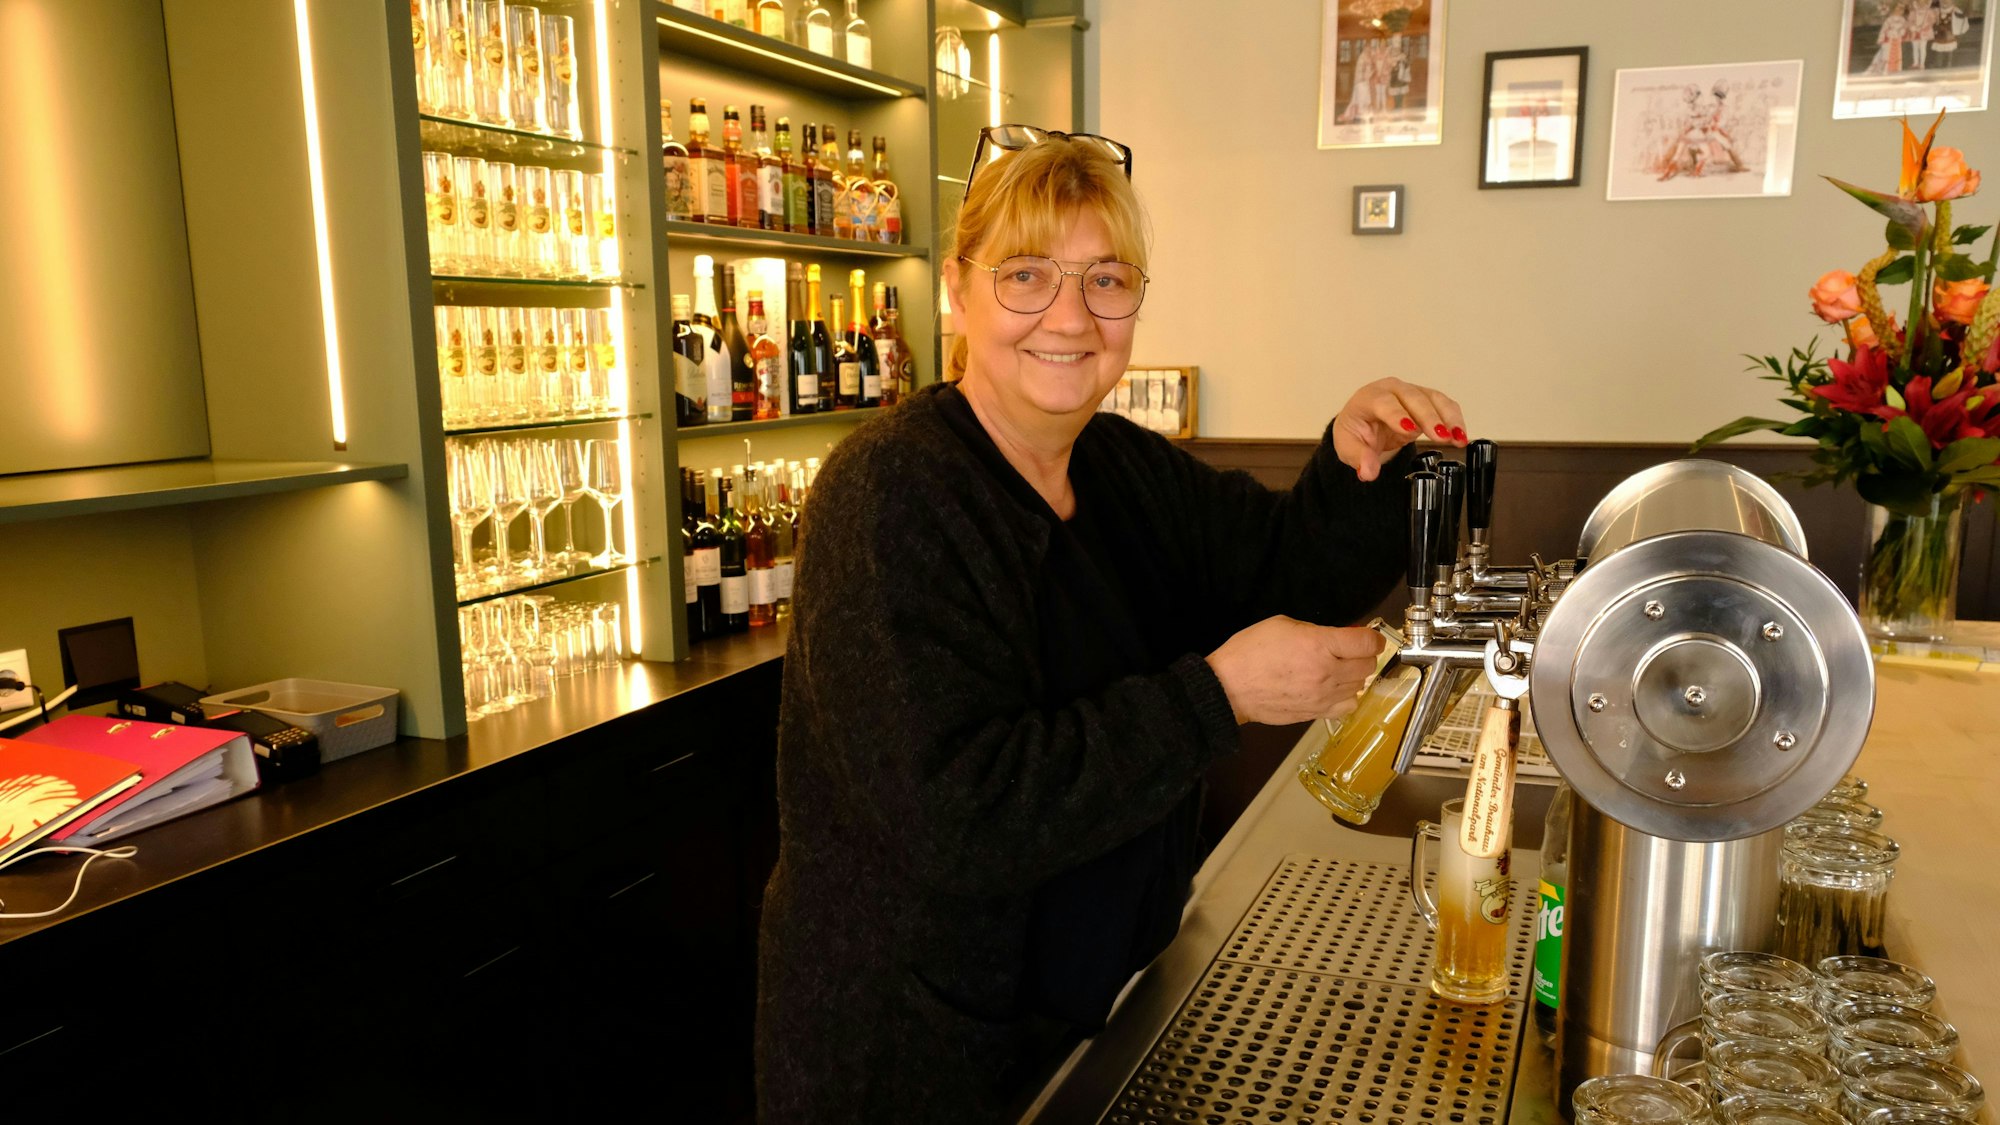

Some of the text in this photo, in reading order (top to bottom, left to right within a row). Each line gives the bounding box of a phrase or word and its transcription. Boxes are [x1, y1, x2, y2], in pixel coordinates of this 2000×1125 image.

[1467, 753, 1487, 842] am Nationalpark
[1481, 747, 1507, 853] Gemünder Brauhaus
